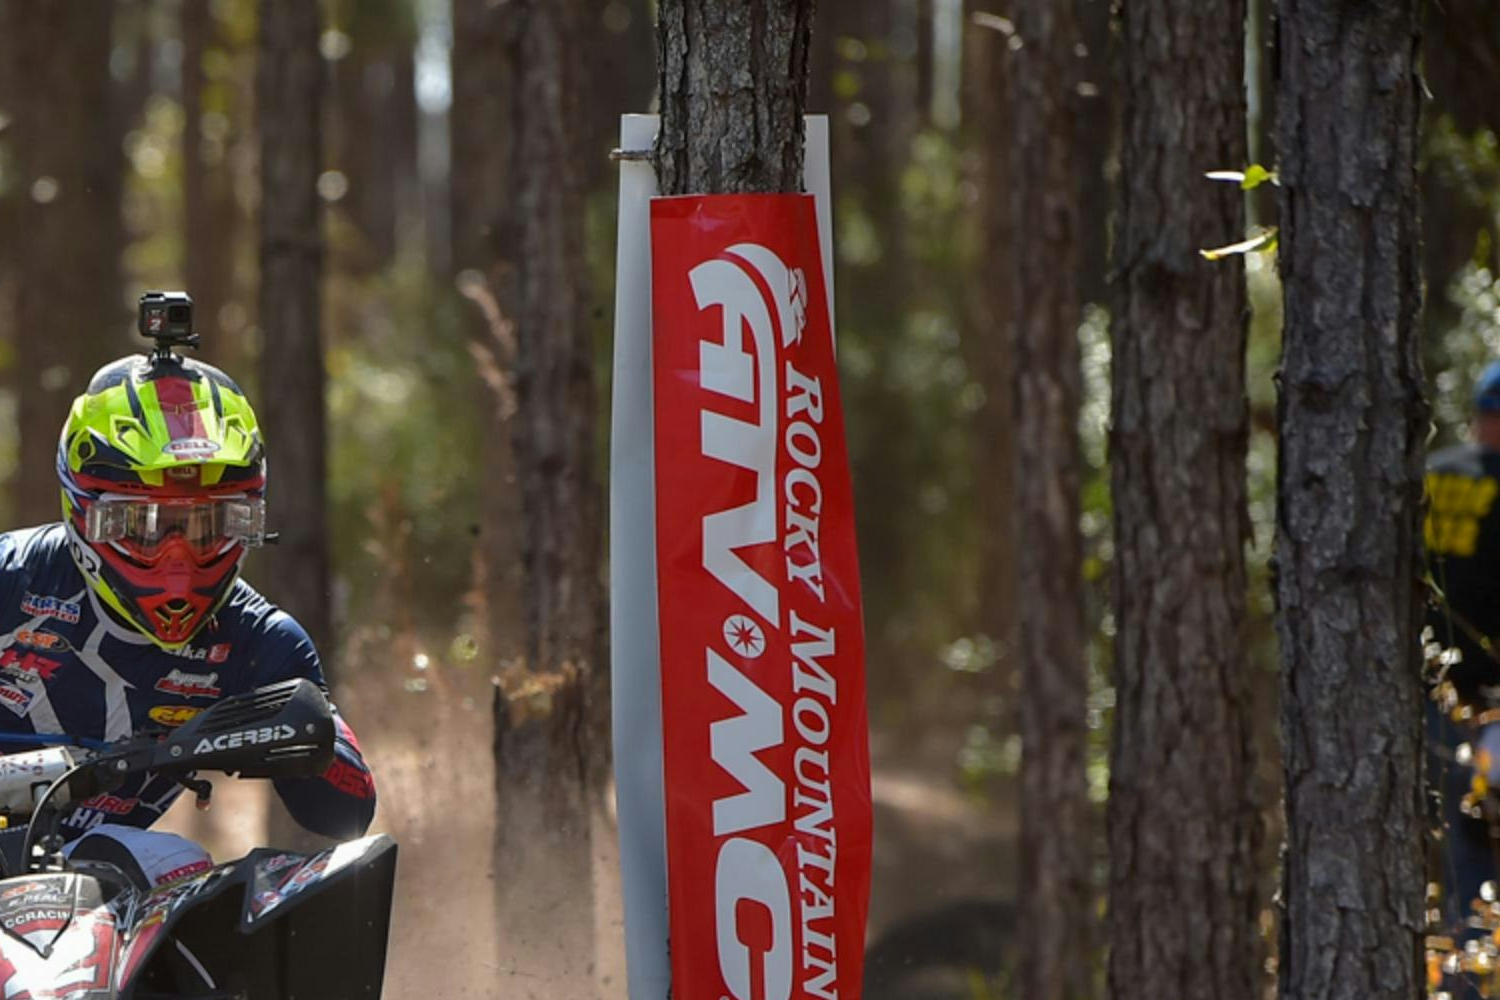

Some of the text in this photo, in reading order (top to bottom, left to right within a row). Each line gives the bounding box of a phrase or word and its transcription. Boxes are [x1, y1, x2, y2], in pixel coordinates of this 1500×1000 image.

[170, 441, 210, 451] BELL
[785, 361, 824, 602] ROCKY
[192, 724, 297, 755] ACERBIS
